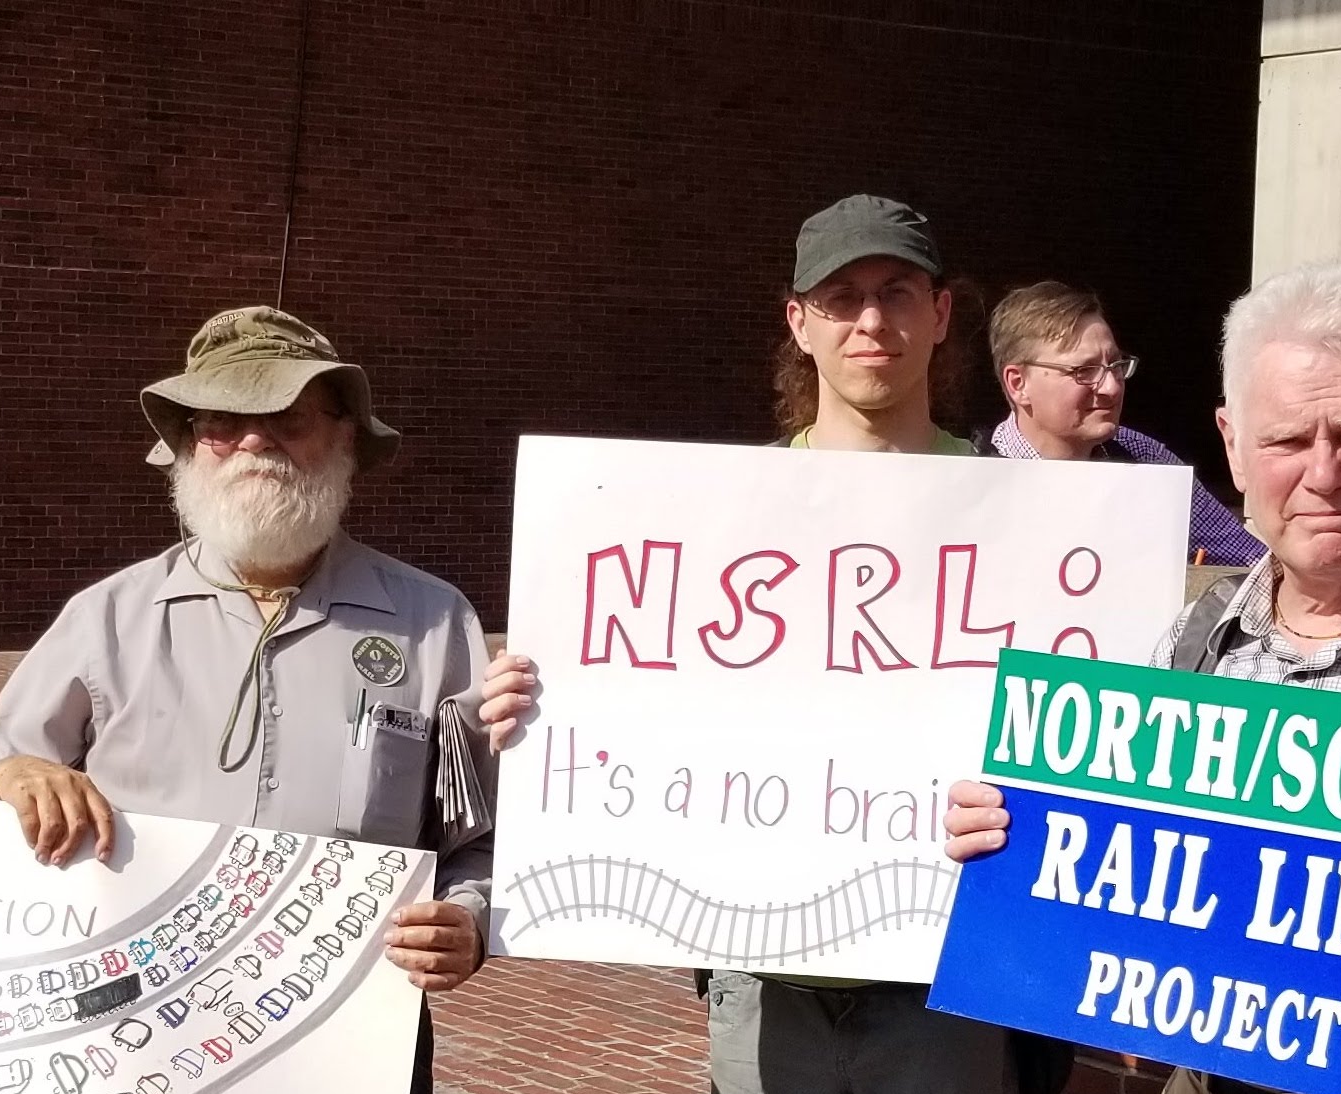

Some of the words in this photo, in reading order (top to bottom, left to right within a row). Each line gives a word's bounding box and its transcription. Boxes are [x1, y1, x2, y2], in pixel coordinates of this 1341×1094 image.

[353, 638, 373, 660] NORTH
[375, 639, 400, 660] SOUTH
[384, 662, 401, 681] LINK
[540, 726, 635, 817] It's
[663, 766, 694, 819] a
[720, 771, 789, 829] no
[823, 758, 954, 843] brai
[1030, 810, 1218, 931] RAIL
